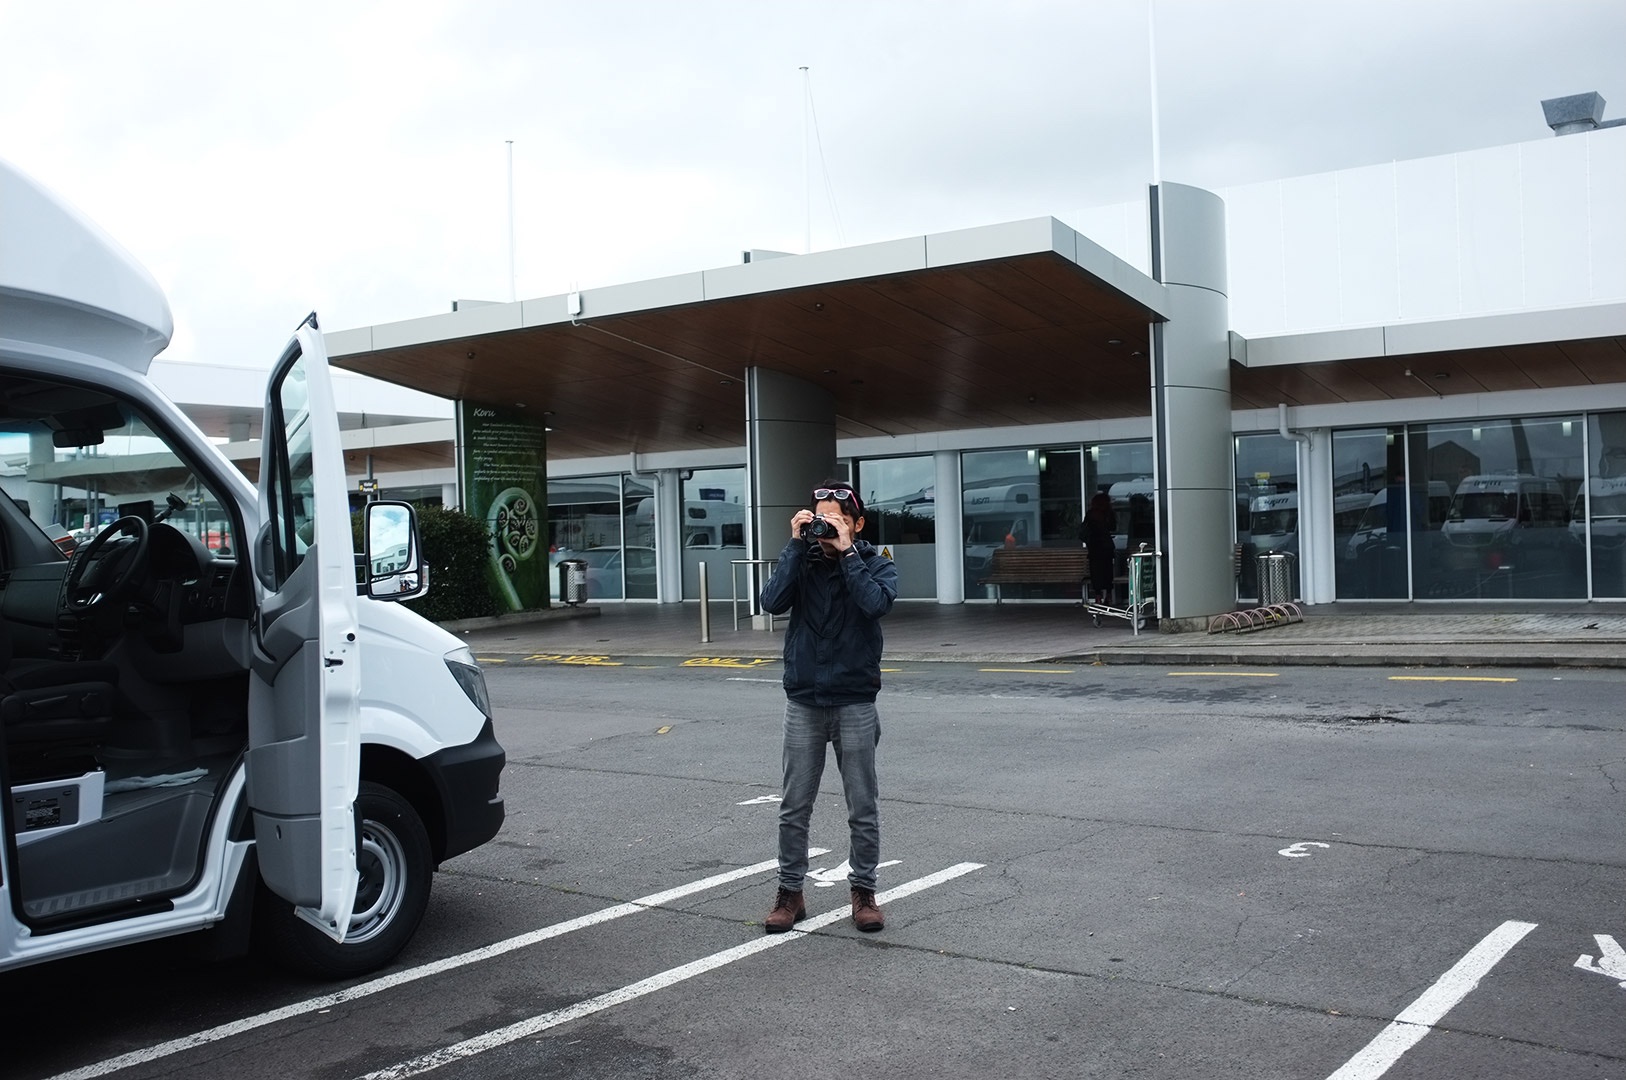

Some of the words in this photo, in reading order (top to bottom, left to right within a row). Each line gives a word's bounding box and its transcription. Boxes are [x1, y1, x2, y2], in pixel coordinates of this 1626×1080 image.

[473, 408, 496, 417] Koru
[522, 655, 610, 663] TAXIS
[683, 657, 777, 666] ONLY
[1277, 841, 1331, 858] 3
